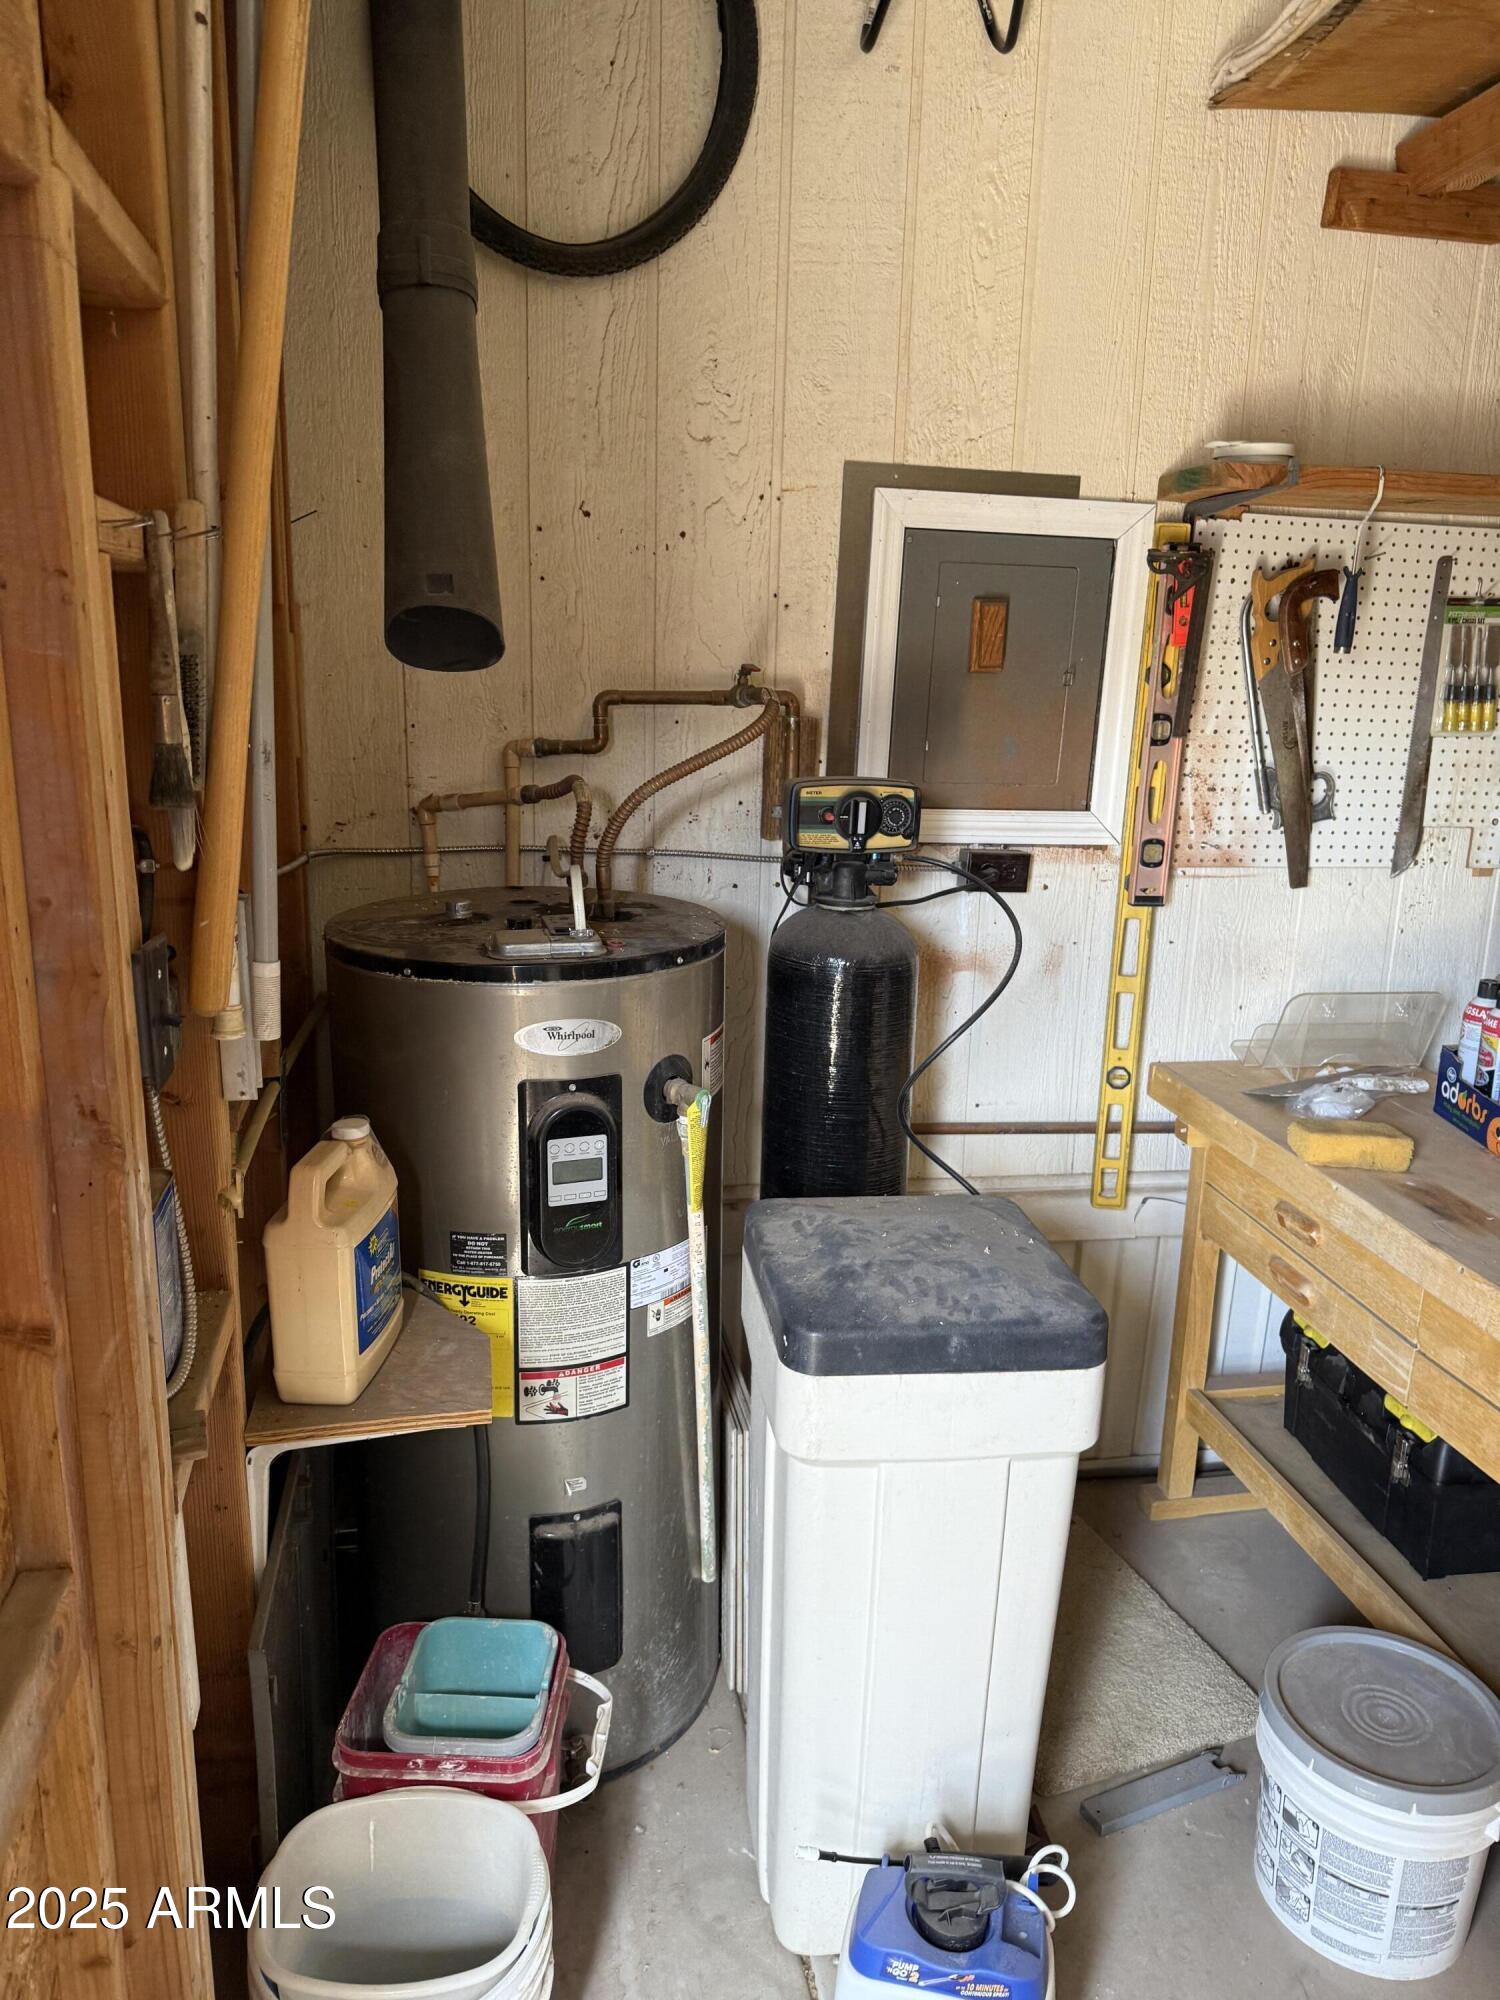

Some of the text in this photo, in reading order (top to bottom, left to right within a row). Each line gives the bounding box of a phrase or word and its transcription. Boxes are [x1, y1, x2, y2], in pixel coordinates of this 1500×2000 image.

[547, 1030, 595, 1042] Whirlpool
[565, 1365, 601, 1376] DANGER
[892, 1961, 919, 1972] PUMP
[892, 1968, 908, 1977] GO
[908, 1972, 919, 1983] 2
[966, 1983, 974, 1991] 10
[976, 1984, 1004, 1992] MINUTES
